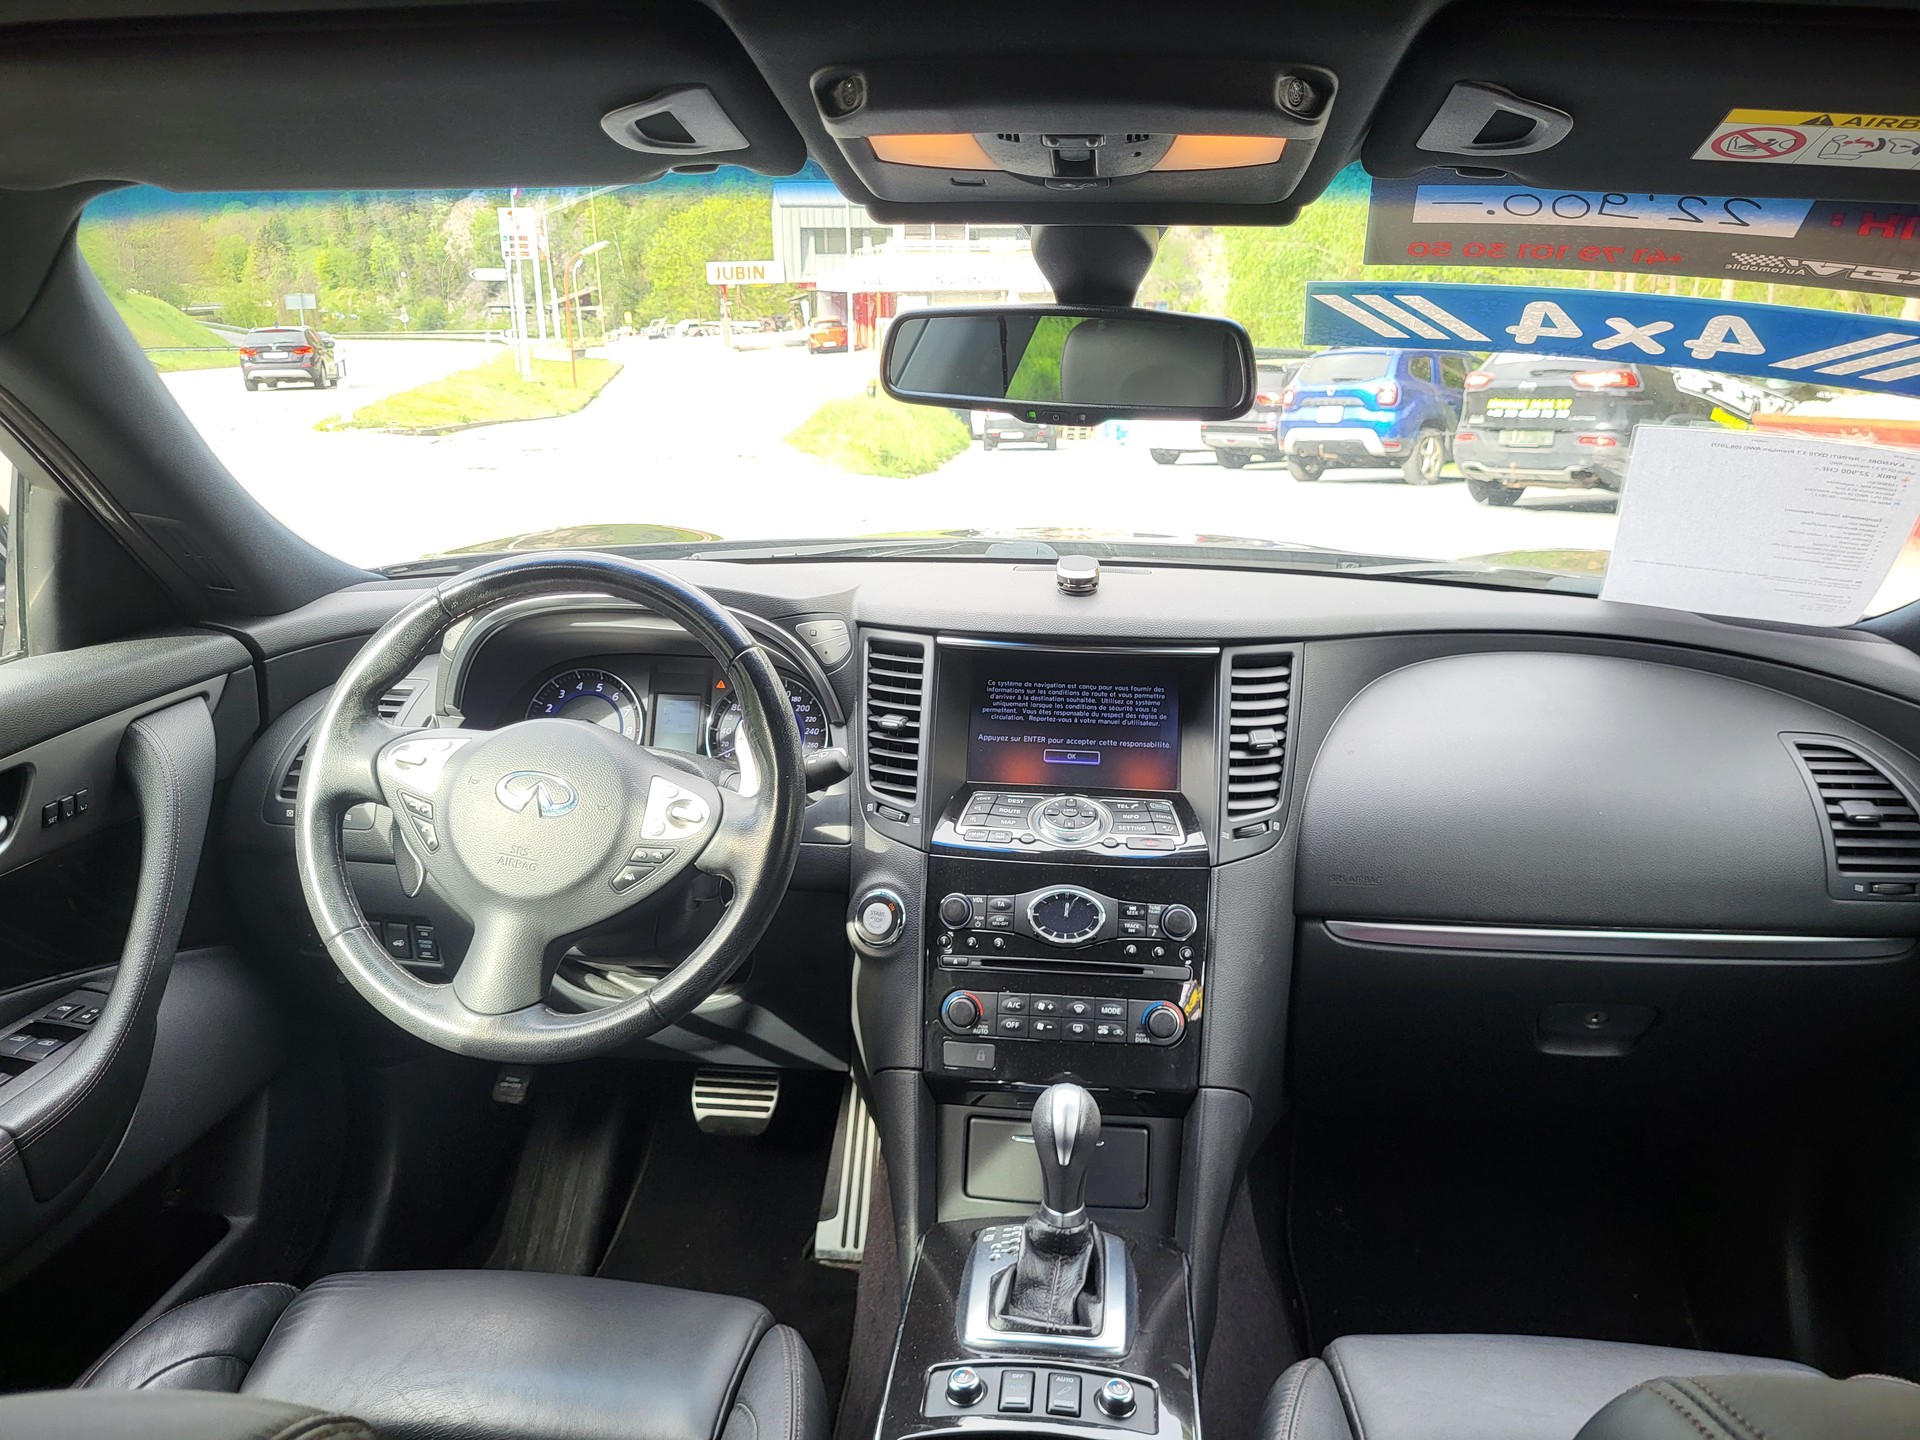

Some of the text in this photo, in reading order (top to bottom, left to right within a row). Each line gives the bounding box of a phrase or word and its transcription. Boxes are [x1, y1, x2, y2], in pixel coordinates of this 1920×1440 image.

[716, 265, 765, 280] JUBIN
[576, 682, 584, 691] 4
[595, 683, 604, 692] 5
[558, 689, 566, 699] 3
[611, 692, 619, 701] 6
[545, 703, 553, 713] 2
[795, 704, 811, 712] 200
[1053, 709, 1090, 718] responsable
[1028, 715, 1072, 723] Reportez-vous
[626, 726, 633, 735] 8
[804, 728, 820, 736] 240
[978, 733, 1009, 743] Appuyez
[1024, 735, 1046, 743] ENTER
[1047, 738, 1064, 746] pour
[1066, 738, 1097, 746] accepter
[1099, 739, 1118, 747] cette
[1119, 740, 1172, 749] responsabilité.
[510, 845, 530, 857] SRS
[497, 855, 540, 871] AIRBAG
[1101, 1007, 1122, 1015] MODE
